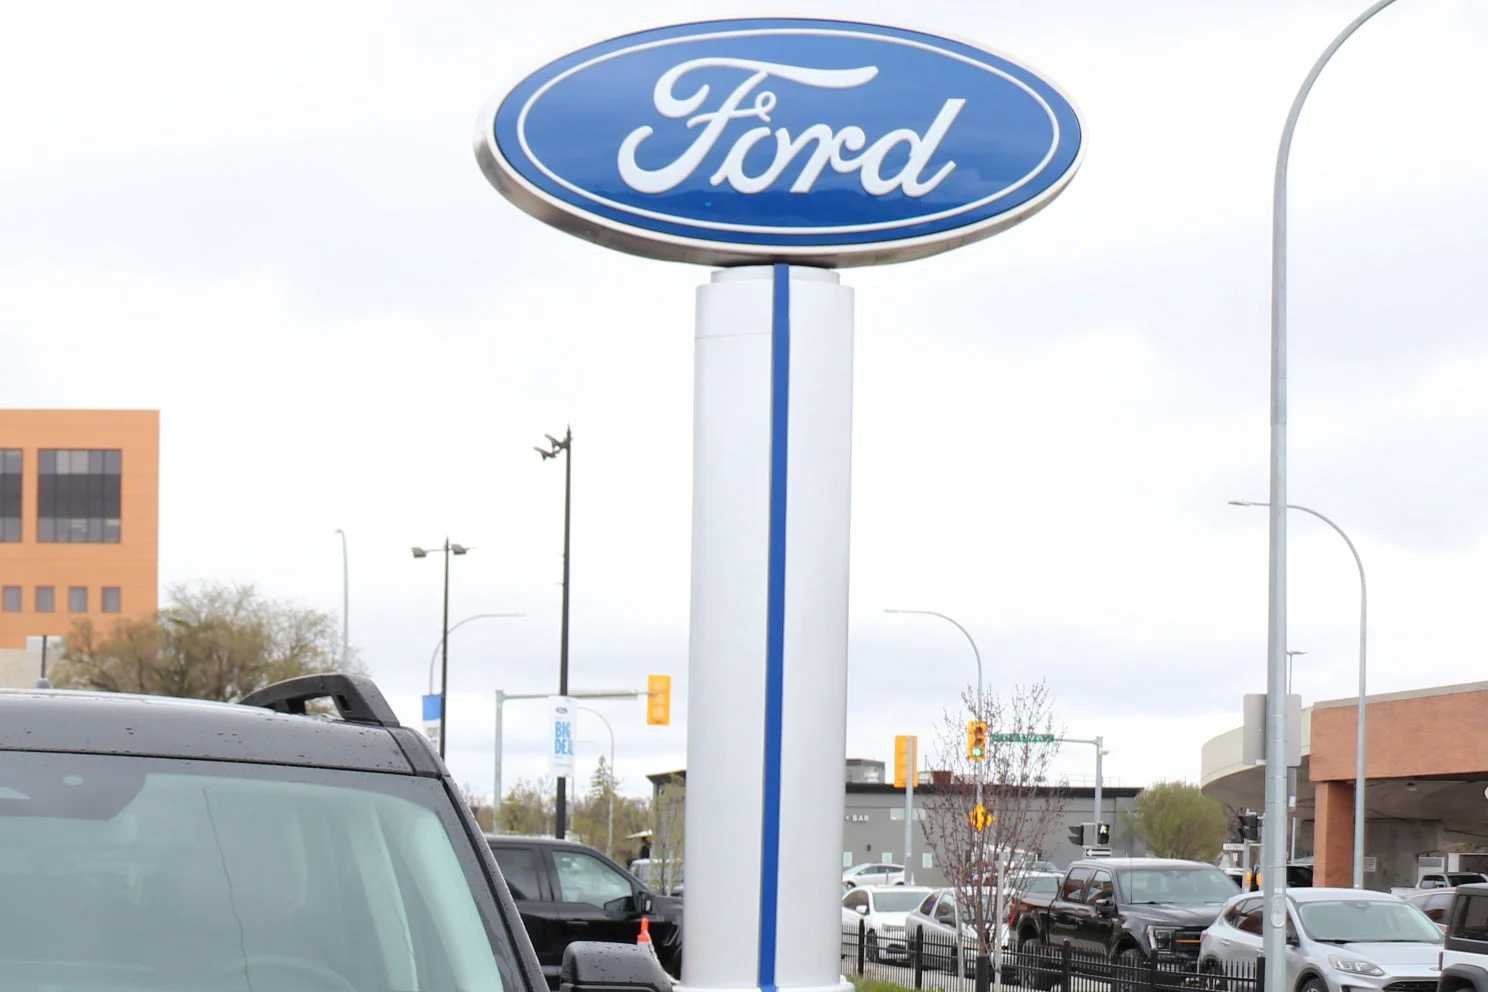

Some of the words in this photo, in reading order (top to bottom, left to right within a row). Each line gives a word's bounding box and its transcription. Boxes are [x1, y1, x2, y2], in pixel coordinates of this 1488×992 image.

[618, 57, 966, 197] Ford
[555, 721, 571, 738] BIG
[852, 814, 869, 822] BAR
